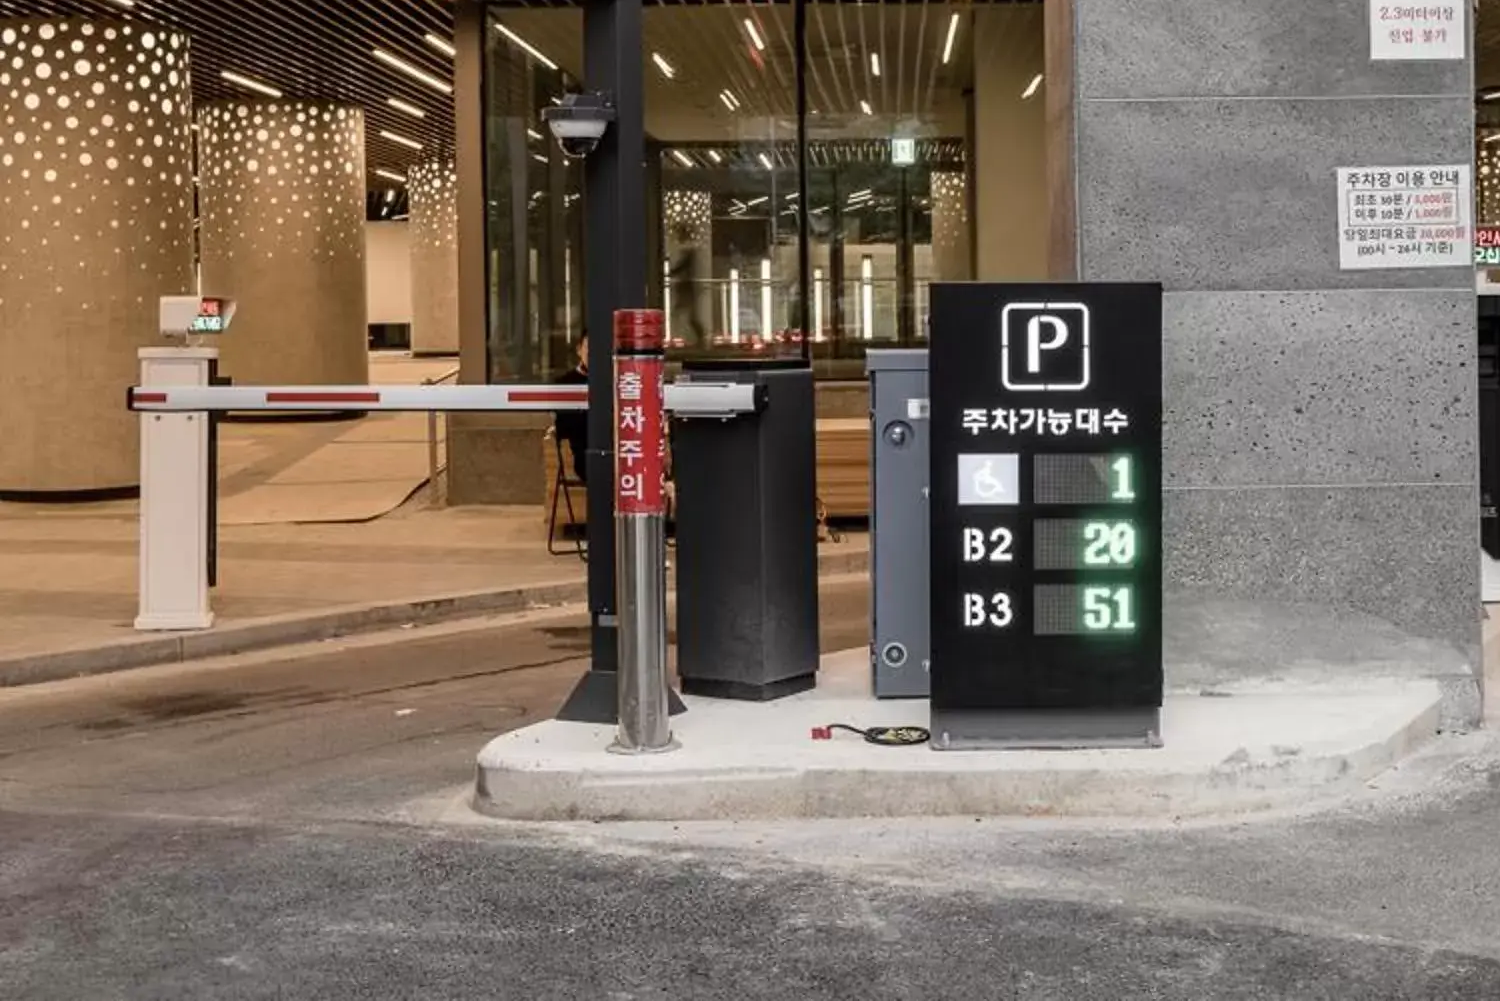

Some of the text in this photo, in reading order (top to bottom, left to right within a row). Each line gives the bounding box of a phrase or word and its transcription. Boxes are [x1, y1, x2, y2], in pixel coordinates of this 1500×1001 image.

[1423, 27, 1447, 44] 불가
[1347, 169, 1460, 188] 주차장 이용 안내
[1027, 315, 1069, 373] P
[618, 372, 645, 501] 출차주의
[962, 408, 1129, 435] 주차가능대수
[1112, 457, 1136, 500] 1
[963, 521, 1136, 565] B2 20
[963, 587, 1136, 630] B3 51
